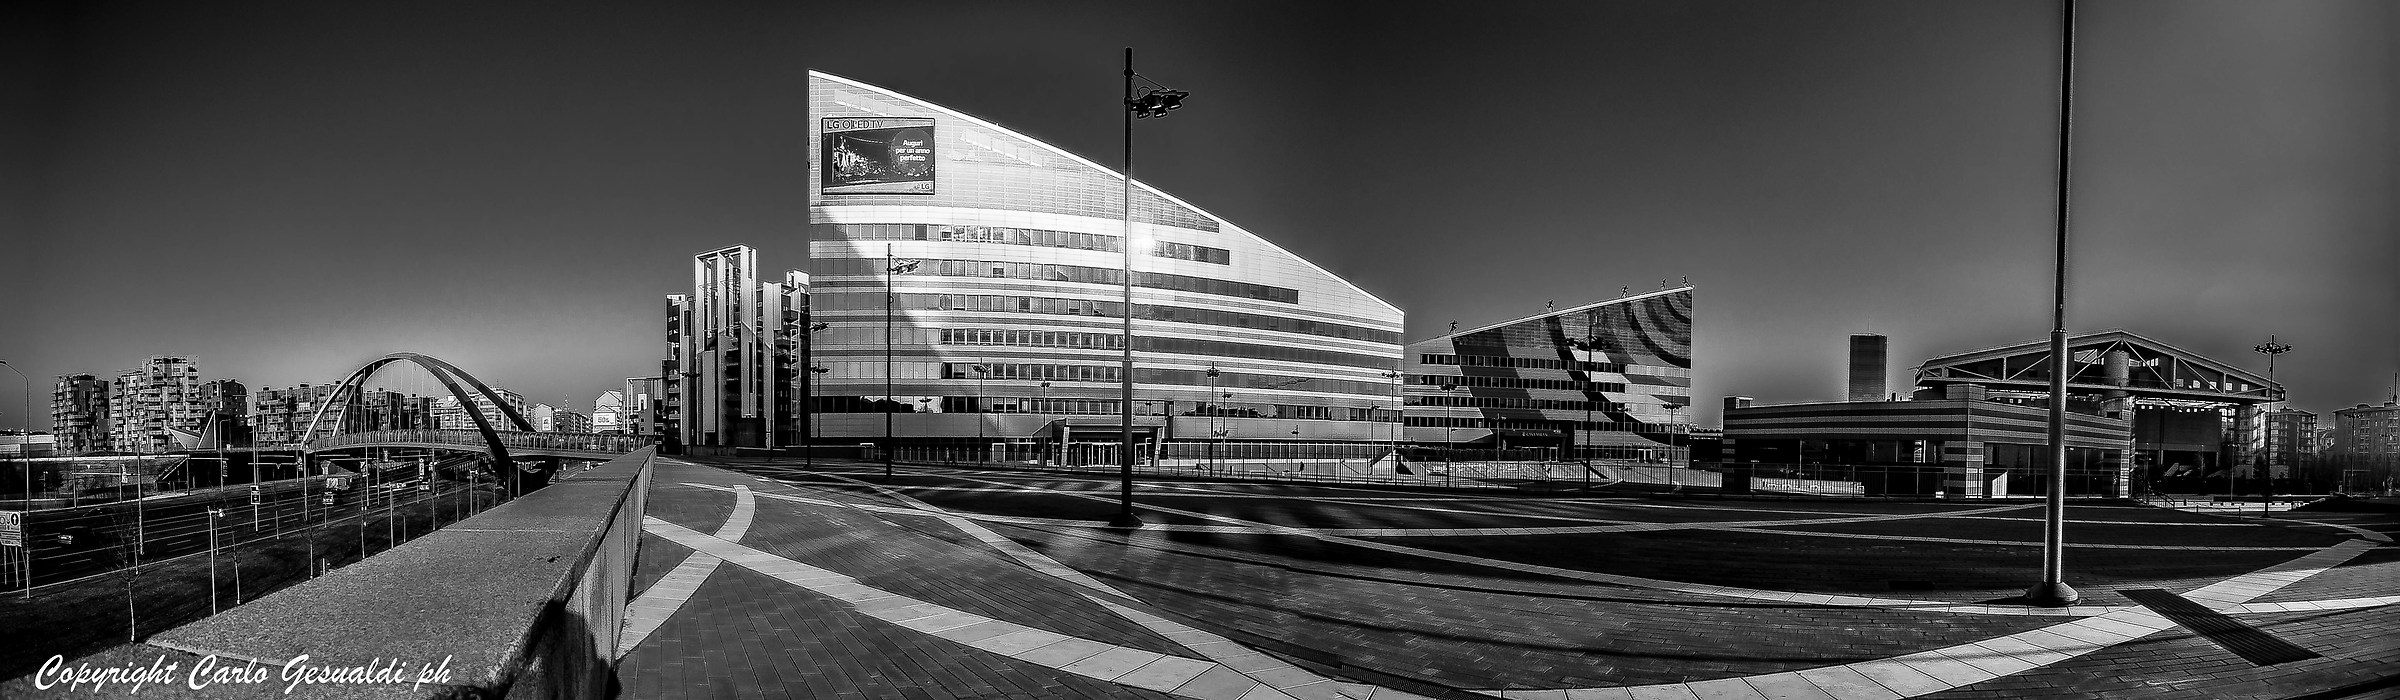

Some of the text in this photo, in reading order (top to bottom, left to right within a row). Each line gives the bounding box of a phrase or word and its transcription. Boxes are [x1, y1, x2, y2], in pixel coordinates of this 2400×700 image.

[827, 119, 883, 129] LG OLED TV
[903, 139, 923, 148] Auguri
[899, 154, 926, 162] perfetto
